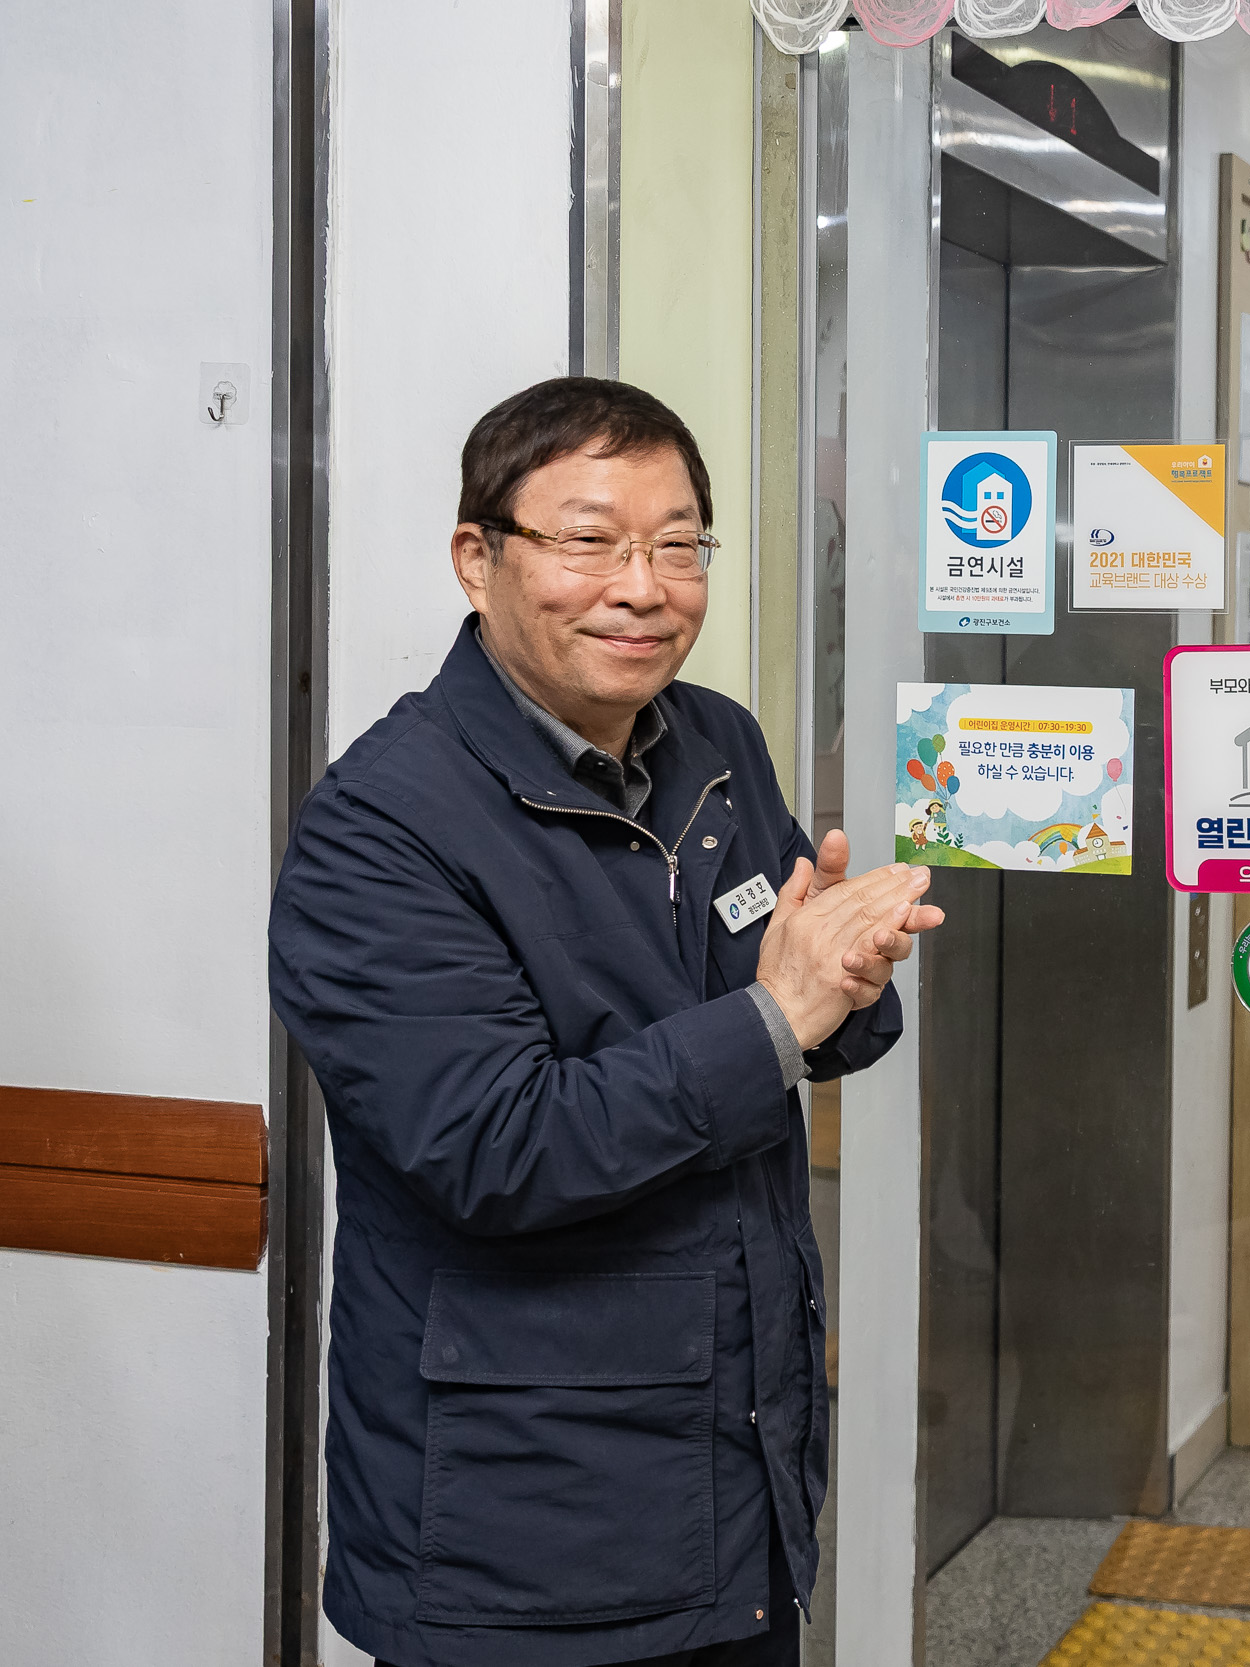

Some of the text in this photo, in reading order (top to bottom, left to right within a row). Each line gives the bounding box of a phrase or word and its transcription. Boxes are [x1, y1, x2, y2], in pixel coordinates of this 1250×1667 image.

[947, 556, 1024, 578] 금연시설
[1089, 551, 1192, 569] 2021 대한민국
[1089, 572, 1208, 590] 교육브랜드 대상 수상
[973, 618, 1011, 627] 광진구보건소
[968, 720, 1087, 732] 어린이집 운영시간 07:30-19:30
[958, 740, 1095, 761] 필요한 만큼 충분히 이용
[977, 763, 1075, 782] 하실 수 있습니다.
